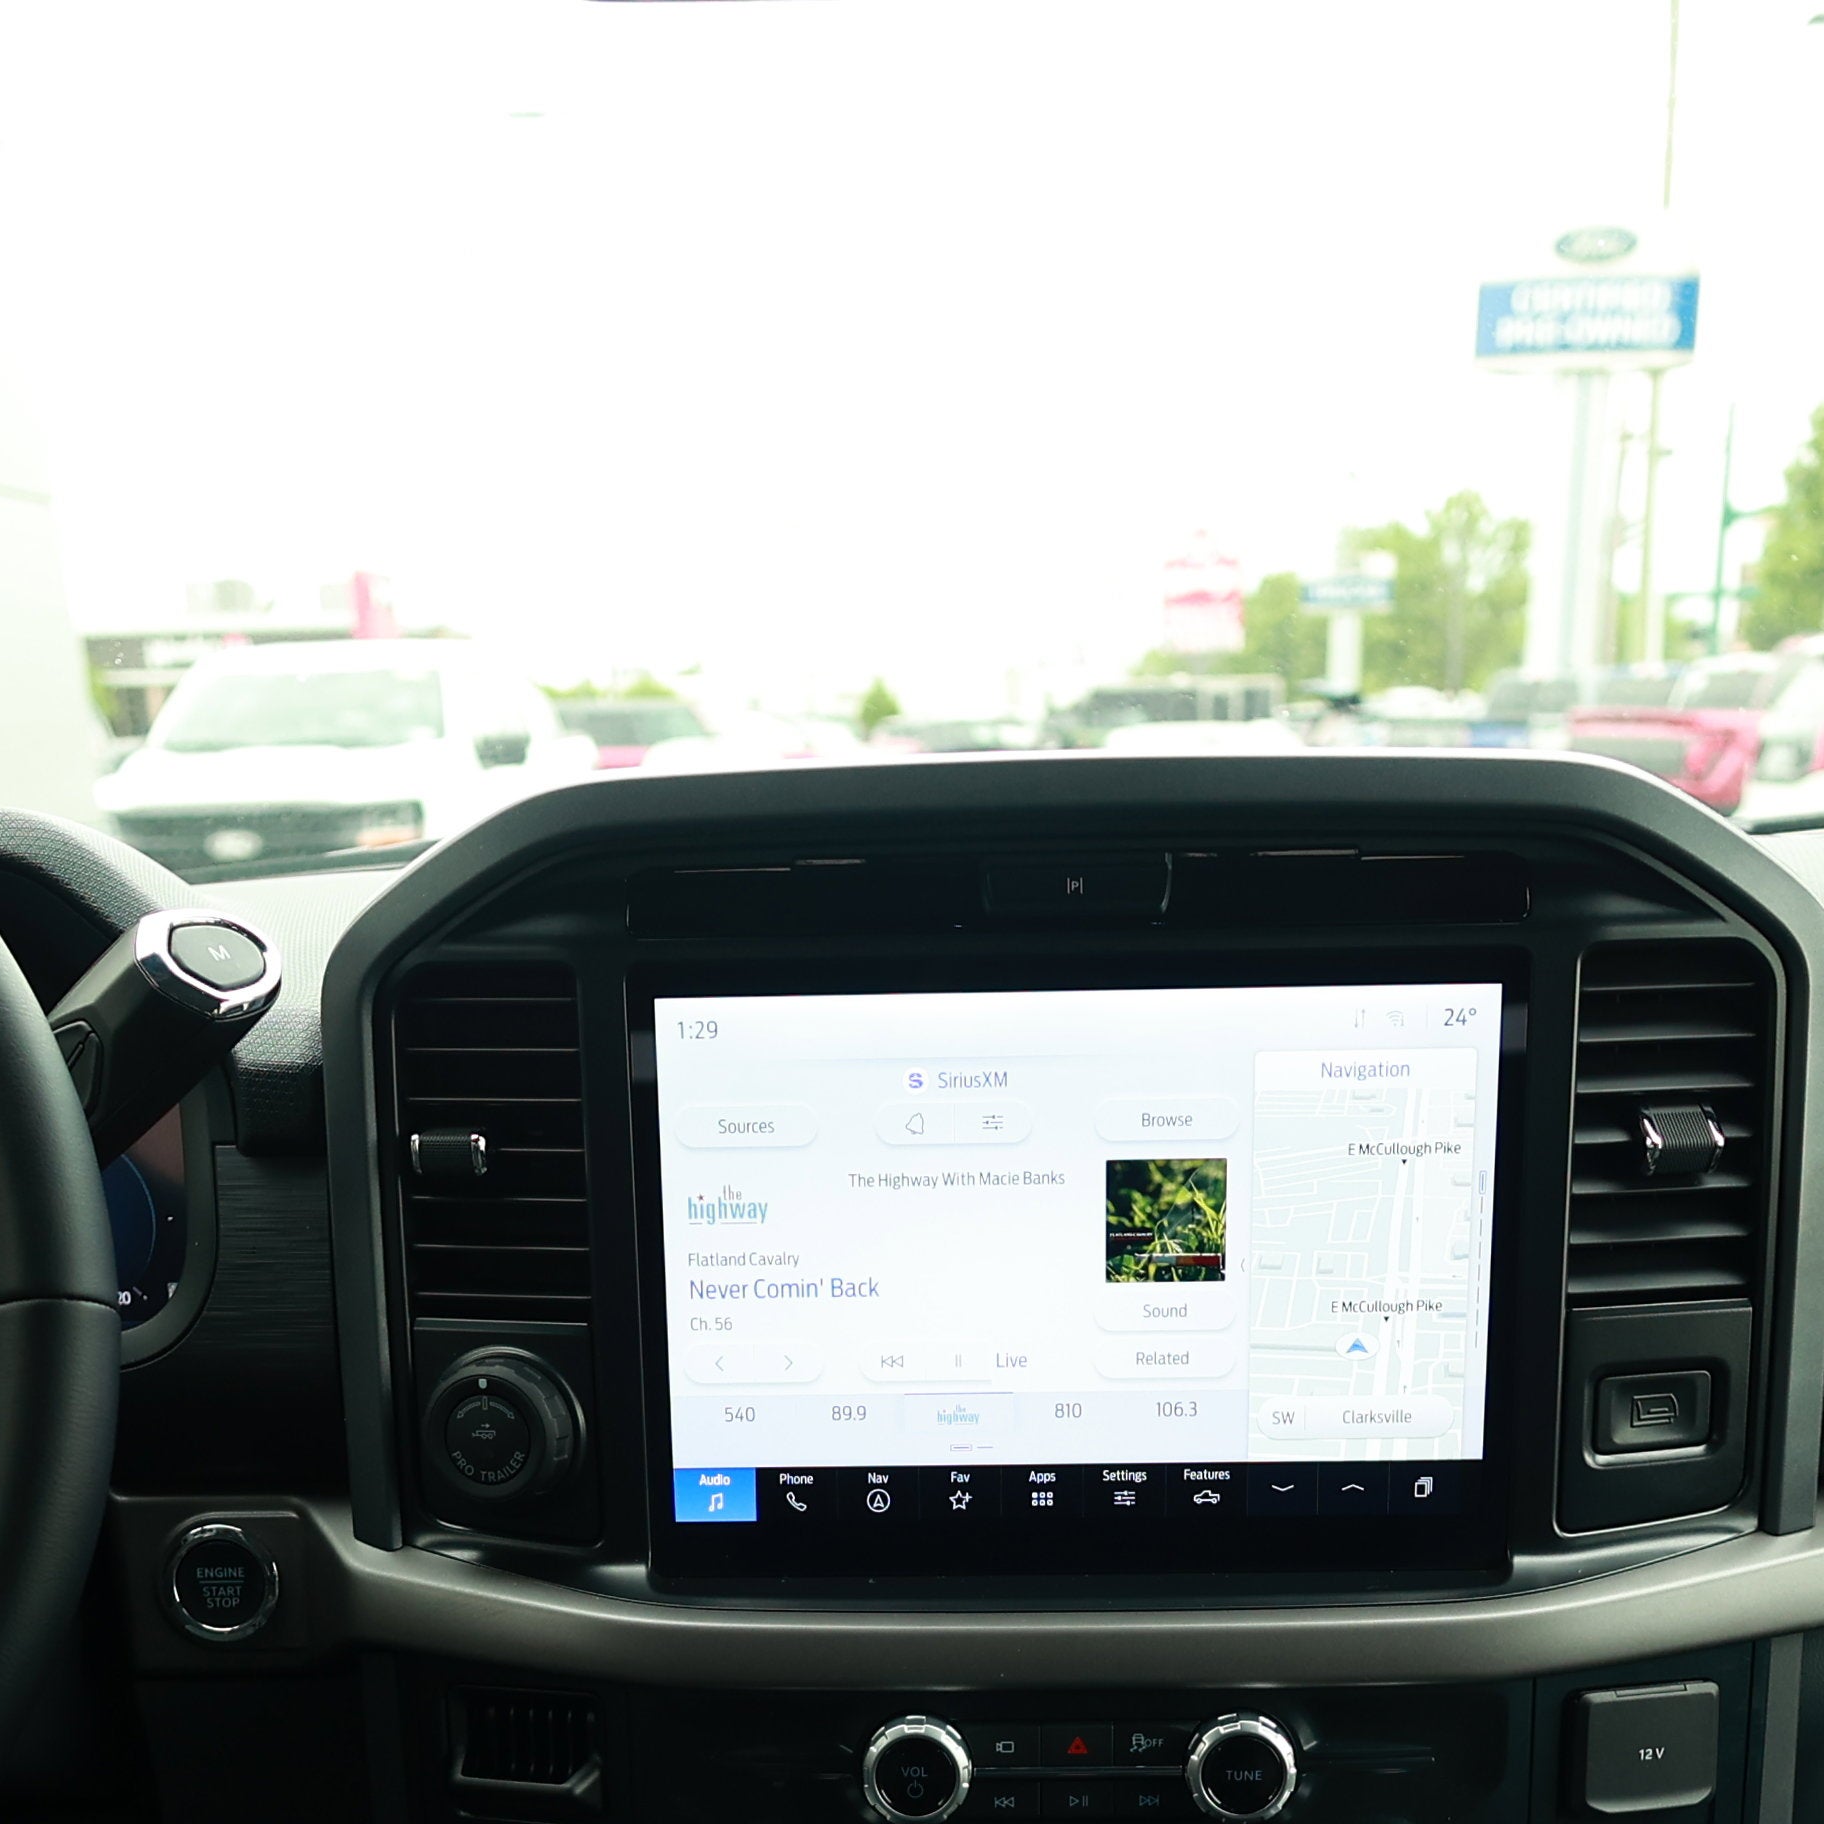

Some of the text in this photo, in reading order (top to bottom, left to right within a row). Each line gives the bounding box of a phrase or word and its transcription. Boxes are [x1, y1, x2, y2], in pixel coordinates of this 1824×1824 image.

[207, 944, 231, 962] M
[1443, 1007, 1477, 1027] 24°
[677, 1020, 719, 1040] 1:29
[1321, 1061, 1411, 1081] Navigation
[938, 1071, 1008, 1090] SiriusXM
[718, 1118, 775, 1135] Sources
[1141, 1112, 1193, 1128] Browse
[1348, 1141, 1462, 1159] E McCullough Pike
[848, 1170, 1065, 1191] The Highway With Macie Banks
[723, 1184, 742, 1201] the
[687, 1196, 768, 1225] highway
[687, 1251, 800, 1268] Flatland Cavalry
[689, 1277, 880, 1300] Never Comin' Back
[1142, 1304, 1188, 1319] Sound
[1331, 1299, 1443, 1315] E McCullough Pike
[690, 1316, 733, 1332] Ch. 56
[995, 1352, 1028, 1369] Live
[1135, 1351, 1190, 1366] Related
[724, 1406, 756, 1422] 540
[831, 1405, 867, 1422] 89.9
[937, 1410, 980, 1425] highway
[1054, 1402, 1082, 1419] 810
[1156, 1401, 1198, 1418] 106.3
[1271, 1410, 1295, 1425] SW
[1342, 1409, 1412, 1425] Clarksville
[451, 1450, 526, 1483] PRO TRAILER
[1183, 1467, 1231, 1481] Features
[699, 1473, 731, 1486] Audio
[779, 1472, 814, 1486] Phone
[867, 1472, 889, 1485] Nav
[950, 1471, 971, 1484] Fav
[1029, 1470, 1057, 1485] Apps
[1102, 1468, 1148, 1484] Settings
[196, 1567, 245, 1579] ENGINE
[202, 1586, 242, 1598] START
[206, 1597, 240, 1609] STOP
[1143, 1737, 1164, 1749] OFF
[1638, 1747, 1665, 1761] 12 V
[900, 1766, 928, 1779] VOL
[1225, 1769, 1263, 1782] TUNE
